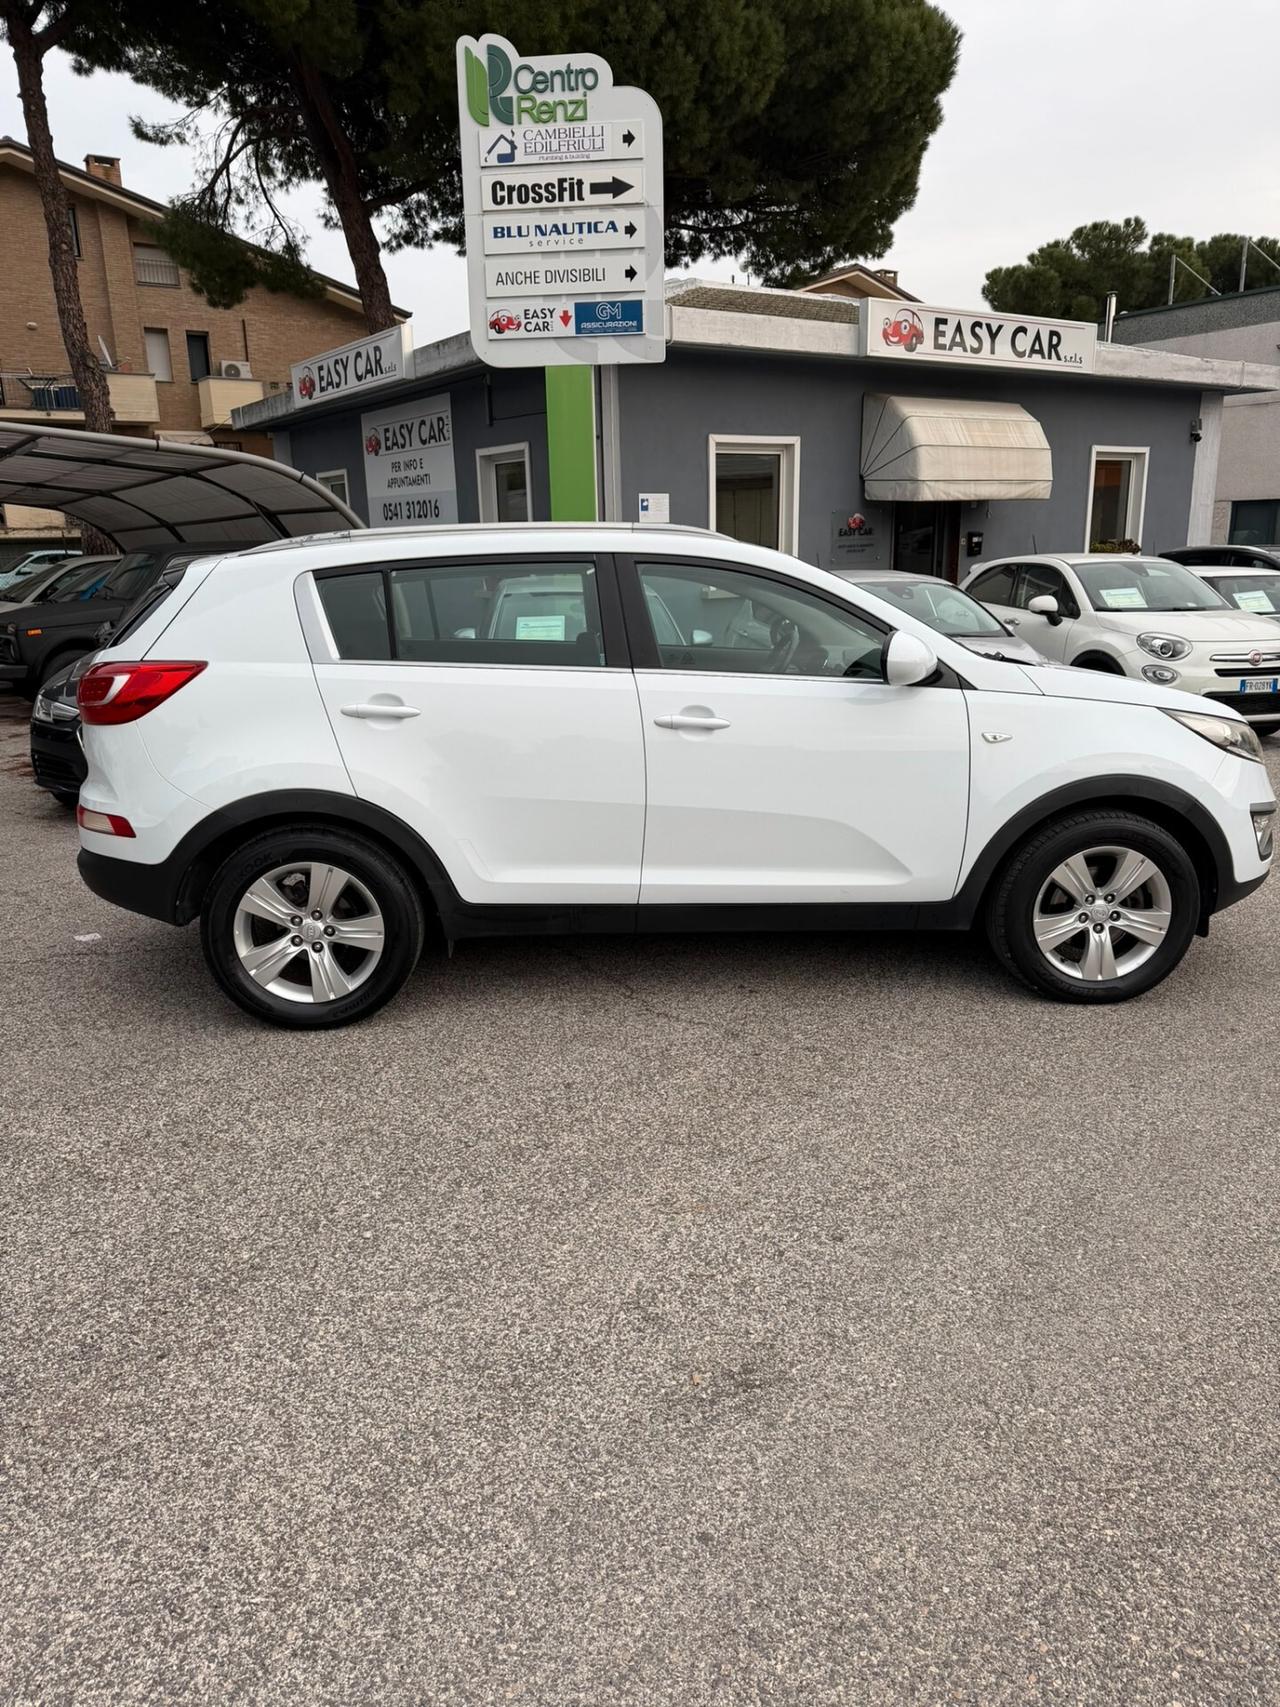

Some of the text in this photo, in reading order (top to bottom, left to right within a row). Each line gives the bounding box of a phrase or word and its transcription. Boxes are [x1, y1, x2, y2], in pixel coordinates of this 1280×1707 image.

[513, 62, 599, 94] Centro
[516, 91, 588, 125] Renzi
[523, 125, 604, 141] CAMBIELLI
[523, 137, 605, 154] EDILFRIULI
[491, 177, 585, 206] CrossFit
[492, 220, 619, 239] BLU NAUTICA
[529, 237, 584, 248] service
[495, 267, 606, 286] ANCHE DIVISIBILI
[523, 307, 556, 320] EASY
[595, 302, 622, 320] GM
[523, 320, 550, 333] CAR
[580, 320, 638, 329] ASSICURAZIONI
[933, 316, 1004, 355] EASY
[1010, 325, 1062, 361] CAR
[317, 355, 350, 393] EASY
[354, 345, 384, 383] CAR
[383, 421, 414, 451] EASY
[418, 416, 447, 445] CAR
[391, 458, 424, 473] PER INFO E
[387, 473, 431, 489] APPUNTAMENTI
[382, 498, 440, 521] 0541 312016
